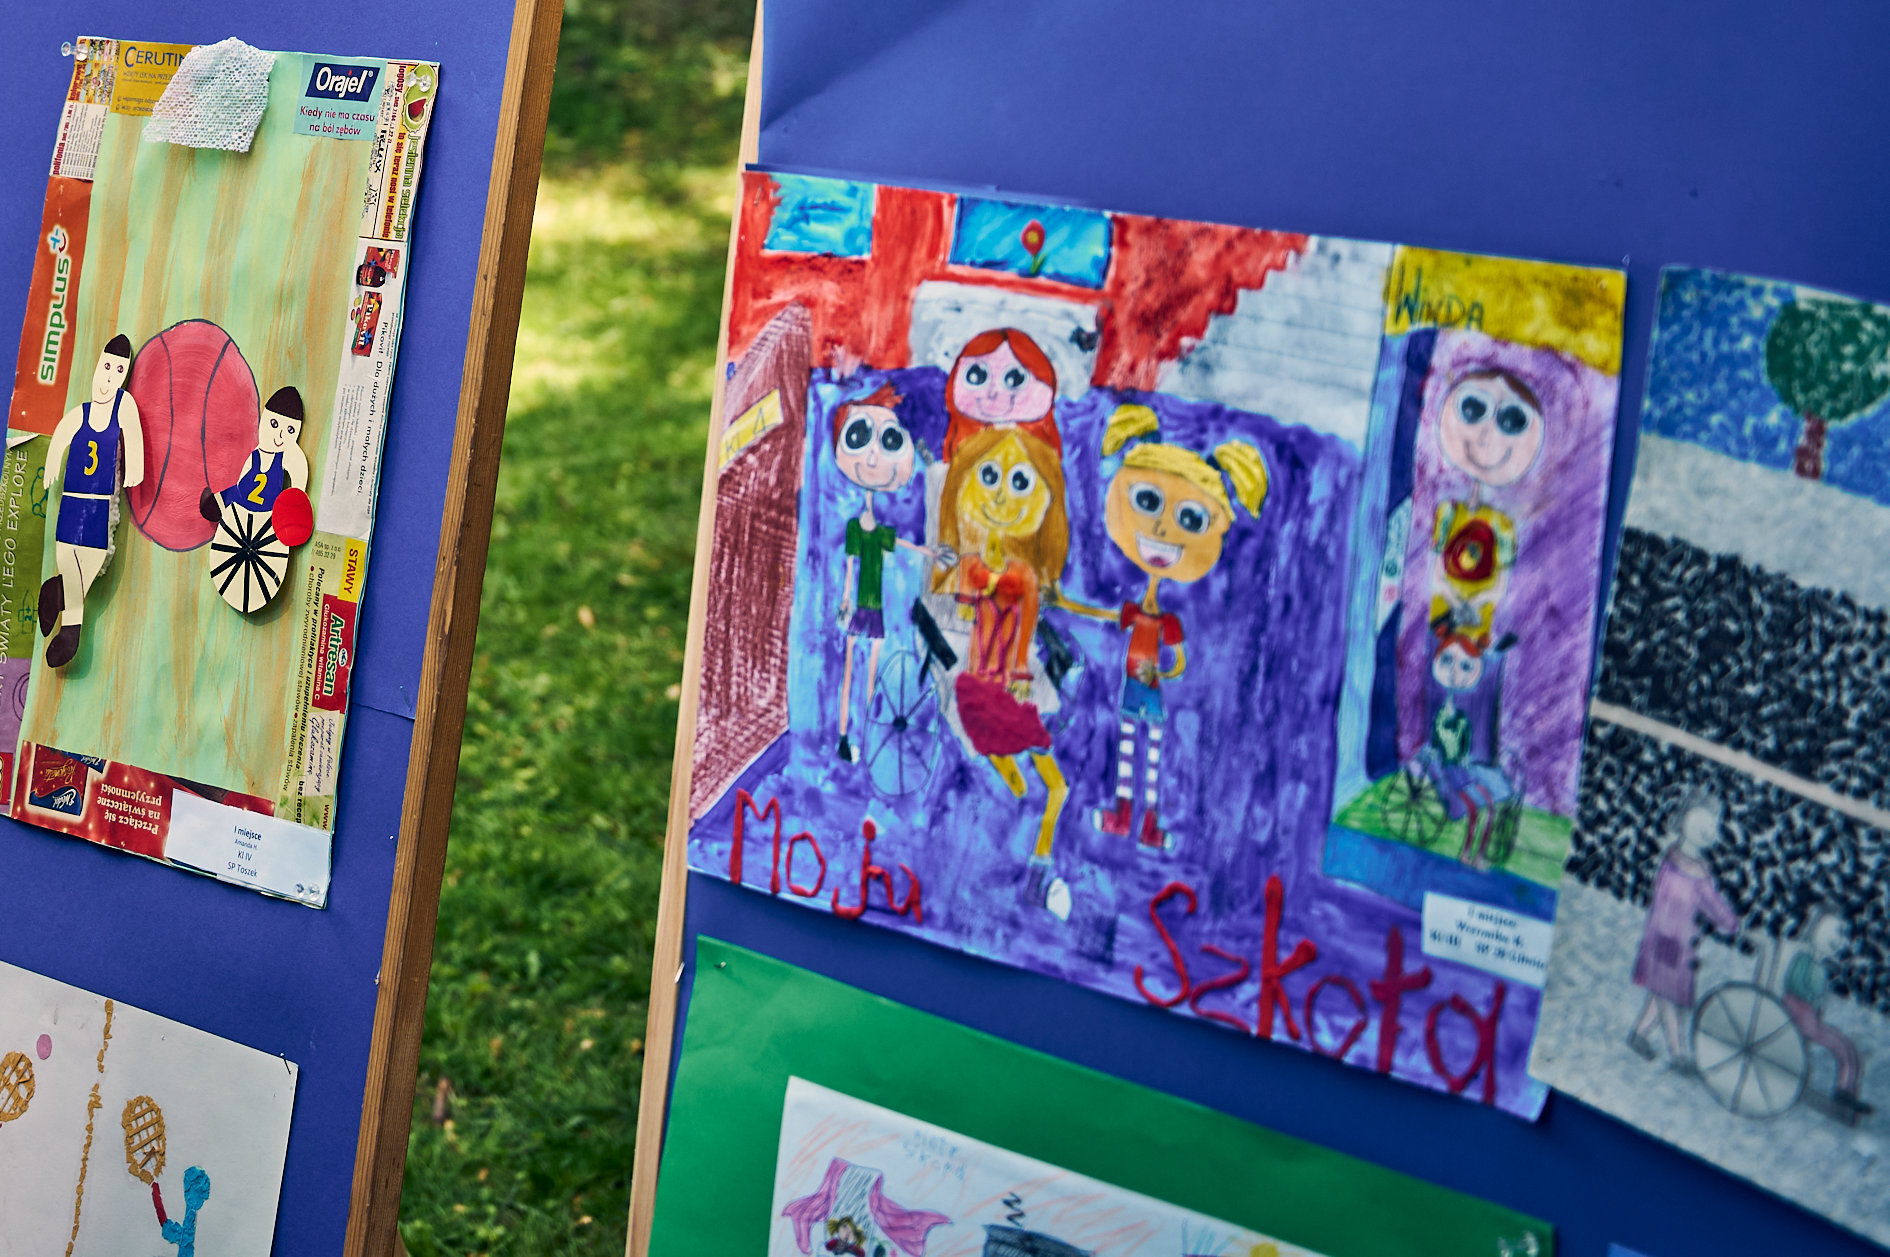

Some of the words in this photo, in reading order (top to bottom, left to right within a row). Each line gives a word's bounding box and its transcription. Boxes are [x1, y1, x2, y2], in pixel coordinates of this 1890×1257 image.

[316, 66, 368, 98] Orajel
[300, 105, 322, 119] Kiedy
[324, 108, 337, 118] nie
[338, 111, 350, 120] ma
[352, 113, 375, 122] czasu
[309, 124, 320, 132] na
[322, 122, 335, 133] ból
[336, 124, 361, 136] zębów
[53, 143, 65, 175] polifonia
[395, 141, 404, 154] się
[392, 155, 402, 175] teraz
[388, 195, 395, 203] w
[389, 177, 398, 194] nosi
[382, 204, 394, 238] telefonie
[40, 258, 70, 382] simplus
[375, 361, 383, 378] Dla
[369, 381, 380, 416] dużych
[84, 440, 99, 476] 3
[362, 426, 372, 461] małych
[6, 450, 28, 530] EXPLORE
[247, 473, 268, 505] 2
[1, 538, 18, 587] LEGO
[342, 548, 359, 594] STAWY
[305, 573, 314, 608] choroby
[313, 567, 325, 607] Polecany
[312, 608, 319, 617] w
[298, 609, 311, 678] zwyrodnieniowej
[308, 618, 320, 669] profilaktyce
[320, 604, 330, 655] Glukozamina
[322, 612, 346, 697] Artresan
[315, 656, 325, 692] witamina
[295, 679, 304, 711] stawów
[301, 676, 313, 731] uzupełnieniu
[290, 719, 299, 757] zapalenia
[283, 758, 293, 792] stawów
[96, 795, 146, 819] świąteczne
[100, 783, 163, 807] przyjemności
[104, 809, 117, 823] się
[118, 815, 159, 835] Przełącz
[148, 809, 161, 821] na
[234, 838, 253, 849] Amanda
[237, 828, 262, 841] miejsce
[227, 861, 236, 870] SP
[237, 863, 258, 878] Toszek
[245, 852, 252, 861] IV
[1133, 874, 1507, 1105] Szkoła
